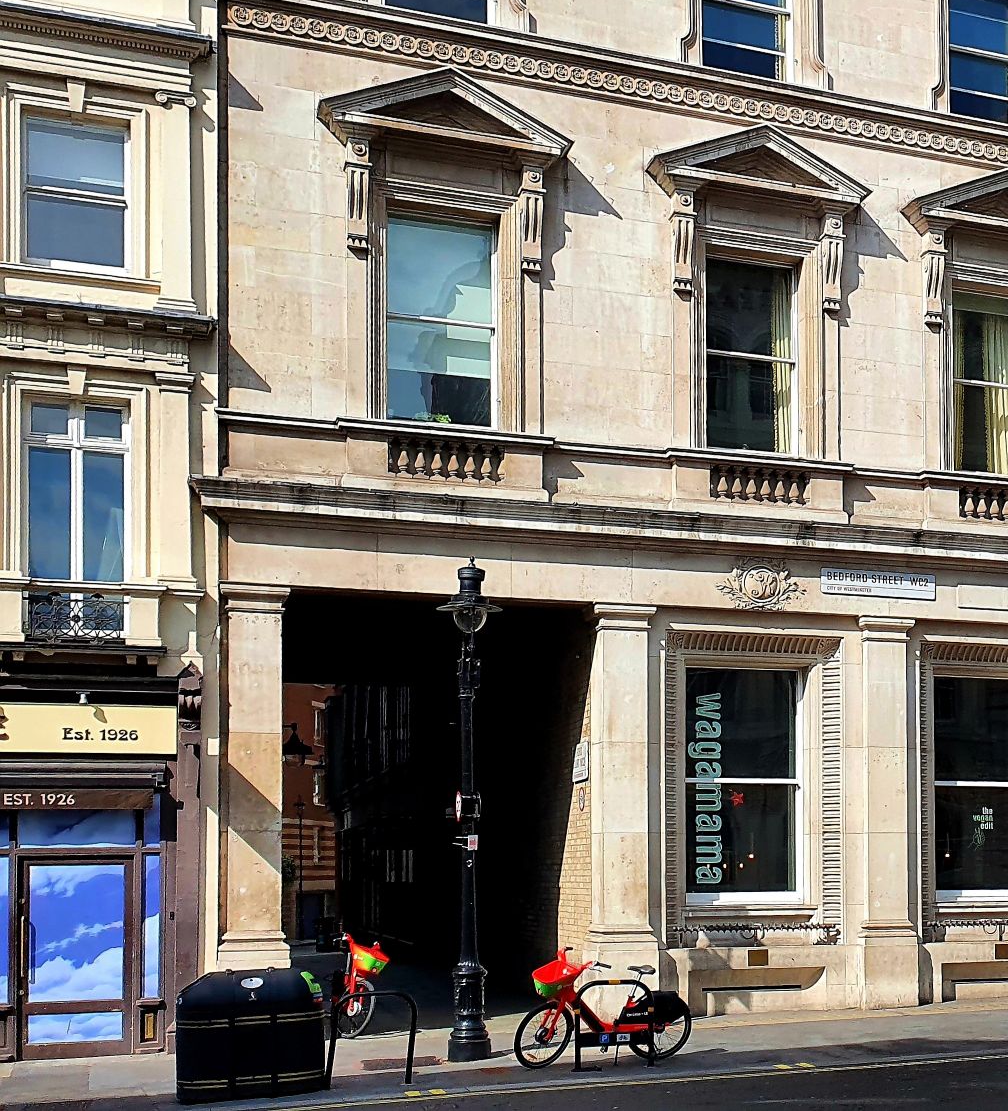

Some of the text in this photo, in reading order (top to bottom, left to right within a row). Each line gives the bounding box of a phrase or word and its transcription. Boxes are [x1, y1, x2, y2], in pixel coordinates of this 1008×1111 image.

[826, 571, 929, 587] BEDFORD STREET WC2
[61, 727, 139, 741] Est. 1926
[687, 692, 723, 885] wagamama
[3, 793, 76, 806] EST. 1926
[982, 806, 994, 815] the
